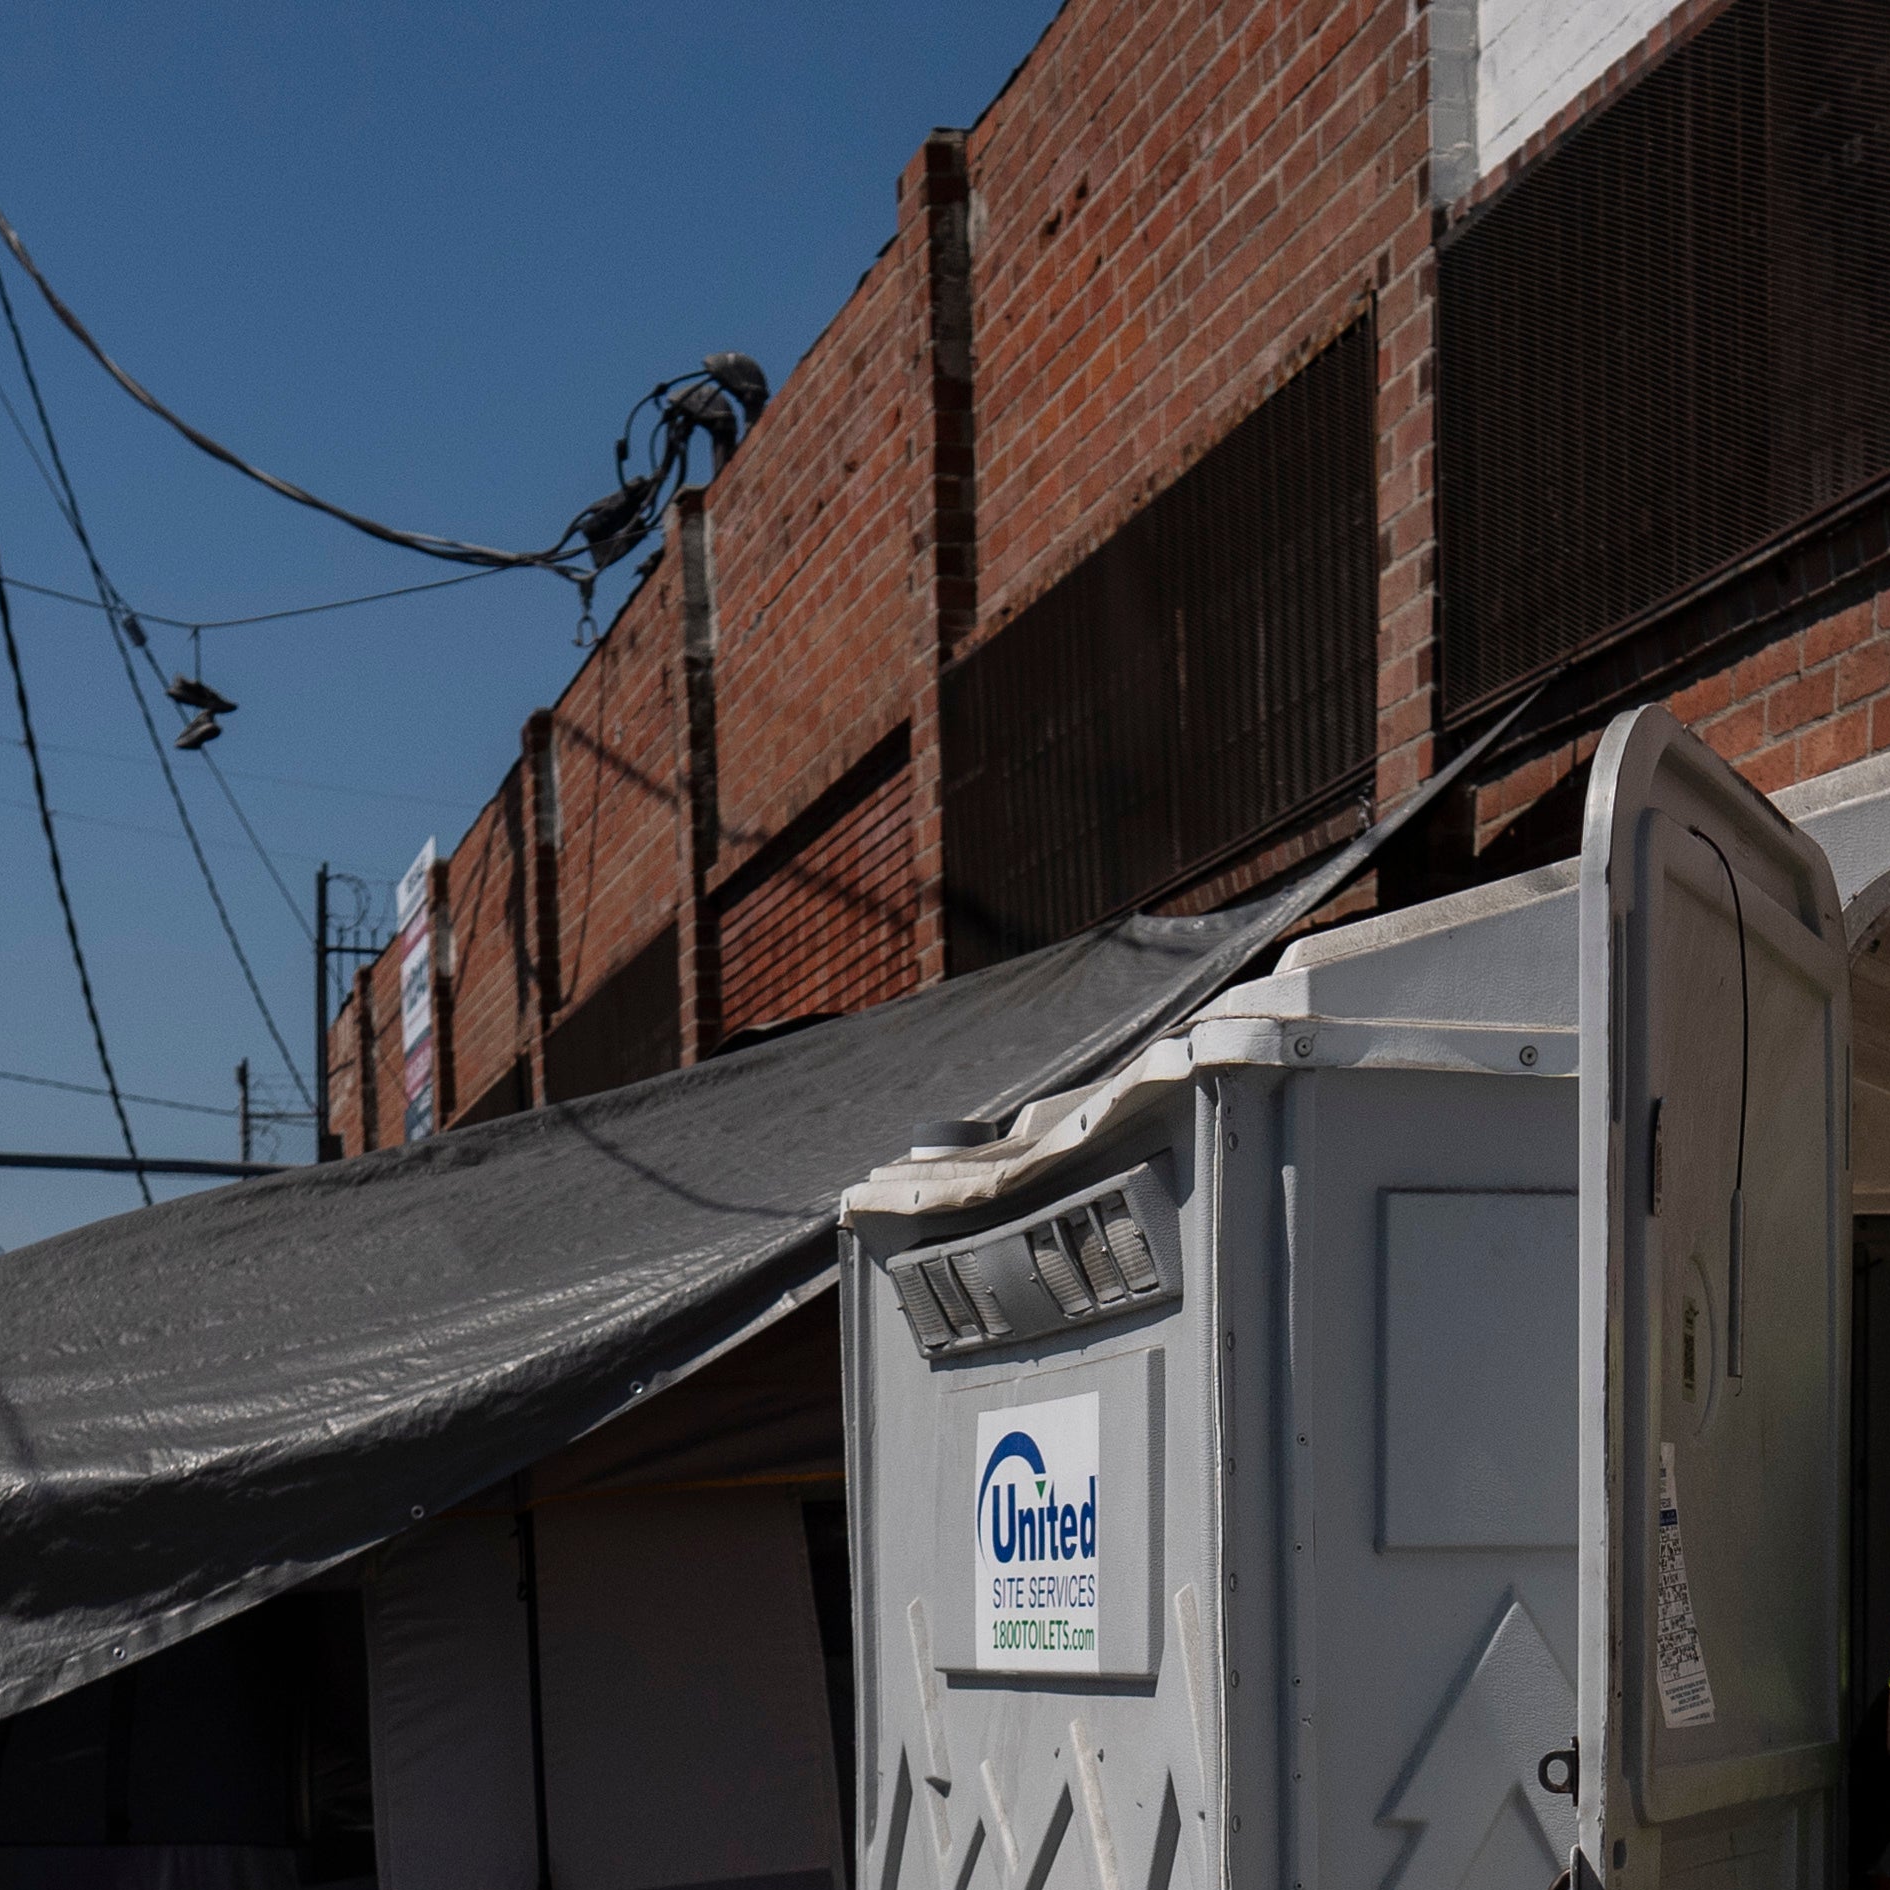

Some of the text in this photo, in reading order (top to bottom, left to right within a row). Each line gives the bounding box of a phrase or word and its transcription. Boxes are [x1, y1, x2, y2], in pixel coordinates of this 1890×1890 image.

[992, 1475, 1096, 1564] United
[992, 1574, 1095, 1609] SITE SERVICES
[992, 1619, 1095, 1651] 1800TOILETS.com
